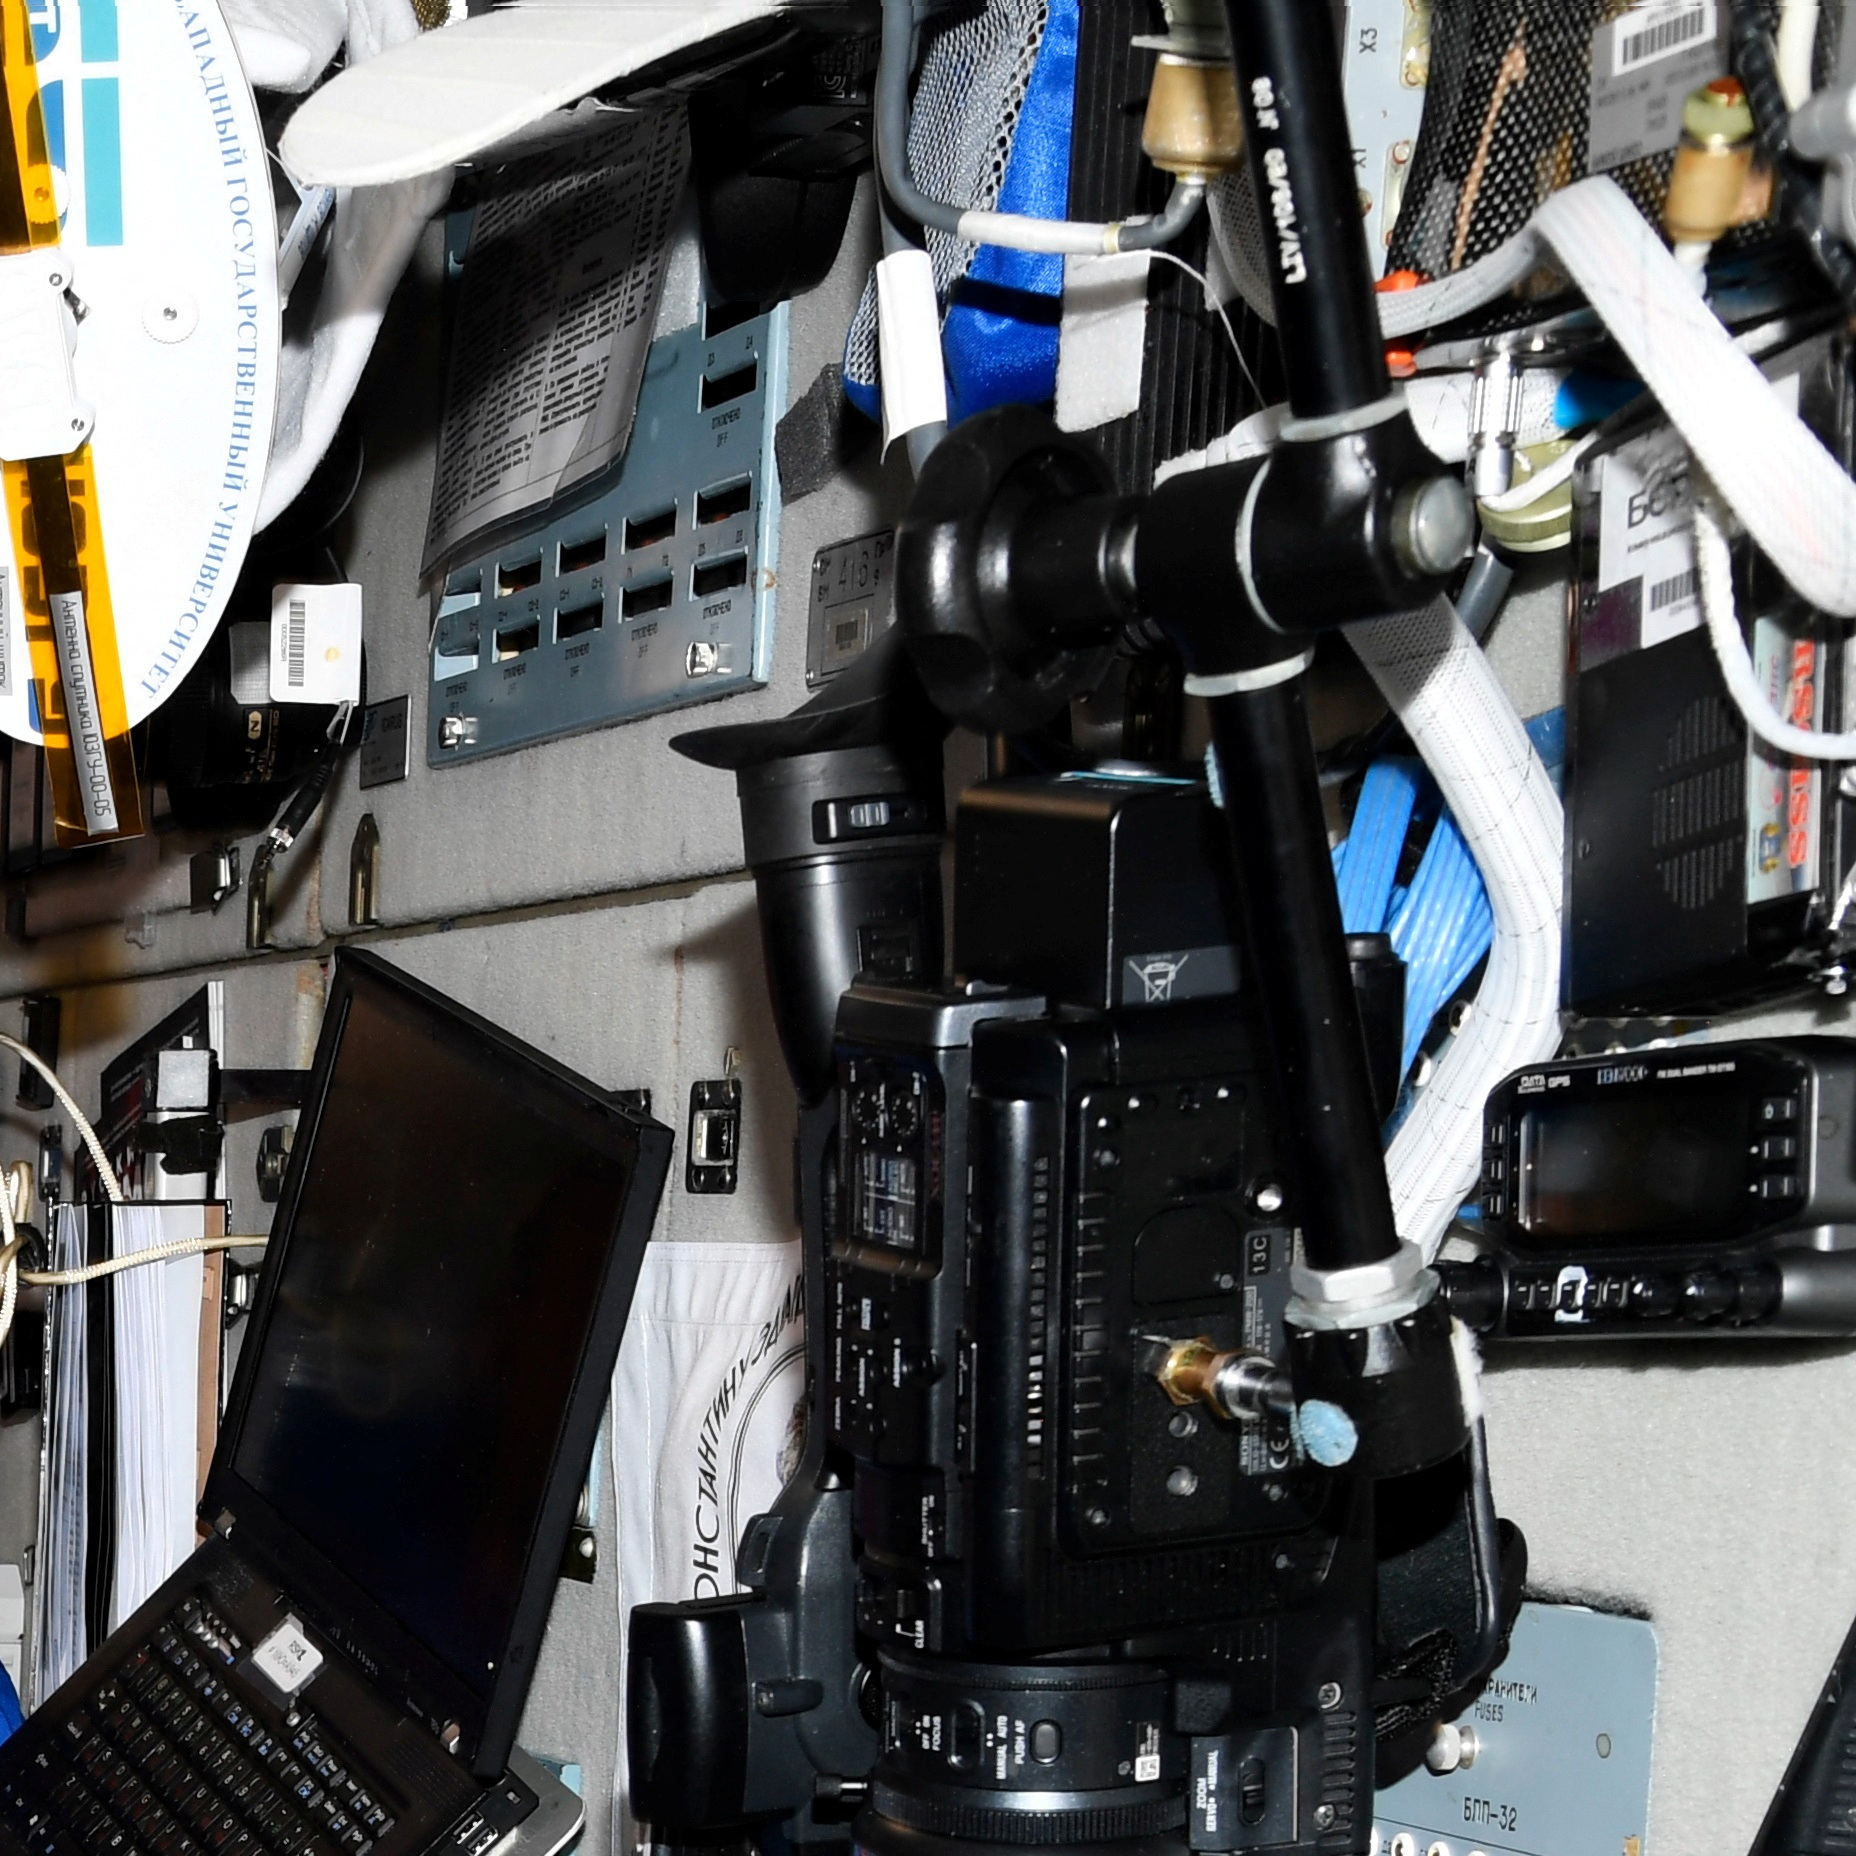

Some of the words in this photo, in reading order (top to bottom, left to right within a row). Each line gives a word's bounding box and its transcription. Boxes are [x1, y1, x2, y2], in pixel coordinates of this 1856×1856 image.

[222, 176, 259, 492] ГОСУДАРСТВЕННЫЙ
[140, 501, 239, 699] УНИВЕРСИТЕТ
[70, 662, 93, 730] спутника
[81, 732, 112, 817] ЮЗГУ-00-05
[1252, 1236, 1268, 1274] 13C
[914, 1619, 925, 1649] CLEAR
[996, 1714, 1008, 1739] AUTO
[1474, 1700, 1504, 1722] FUSES
[932, 1715, 942, 1751] FOCUS
[995, 1743, 1007, 1780] MANUAL
[1014, 1739, 1025, 1765] PUSH
[1207, 1750, 1218, 1786] MANUAL
[1196, 1777, 1207, 1810] ZOOM
[1463, 1796, 1518, 1832] БПП-32
